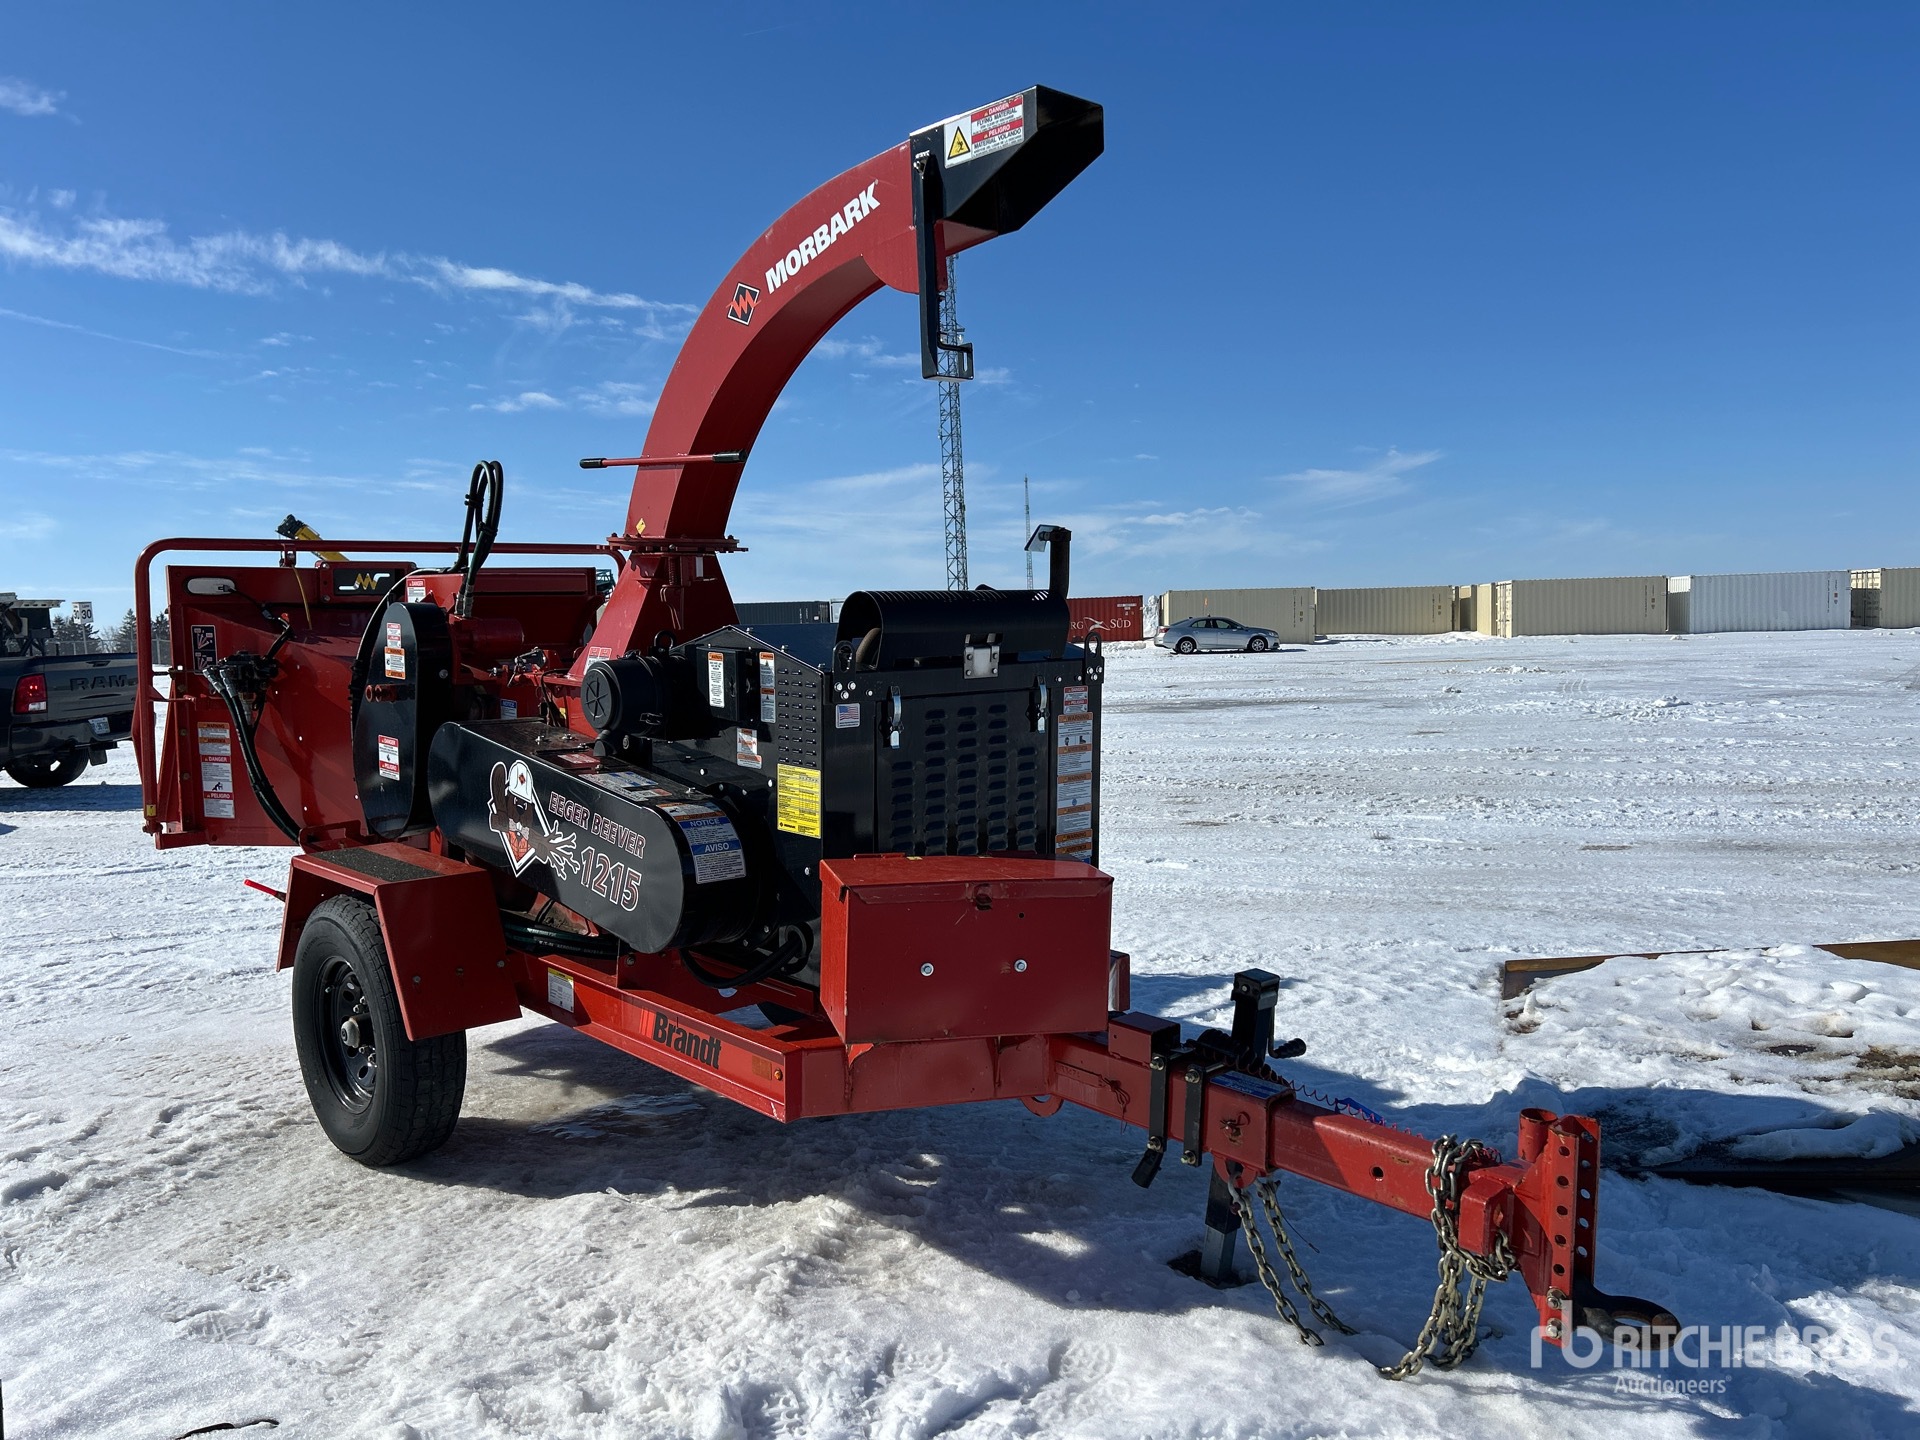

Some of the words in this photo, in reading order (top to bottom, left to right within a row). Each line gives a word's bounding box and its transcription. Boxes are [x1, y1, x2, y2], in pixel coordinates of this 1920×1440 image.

[989, 103, 1009, 114] DANGER
[994, 108, 1017, 120] MATERIAL
[989, 124, 1010, 137] PELIGRO
[974, 138, 996, 149] MATERIAL
[998, 128, 1021, 140] VOLANDO
[765, 182, 880, 294] MORBARK
[81, 609, 92, 619] 30
[1110, 618, 1131, 628] SÜD
[70, 675, 127, 691] RAM
[549, 791, 590, 830] EEGER
[591, 813, 646, 859] BEEVER
[690, 818, 720, 827] NOTICE
[704, 842, 729, 853] AVISO
[581, 846, 642, 911] 1215
[653, 1012, 722, 1069] Brandt
